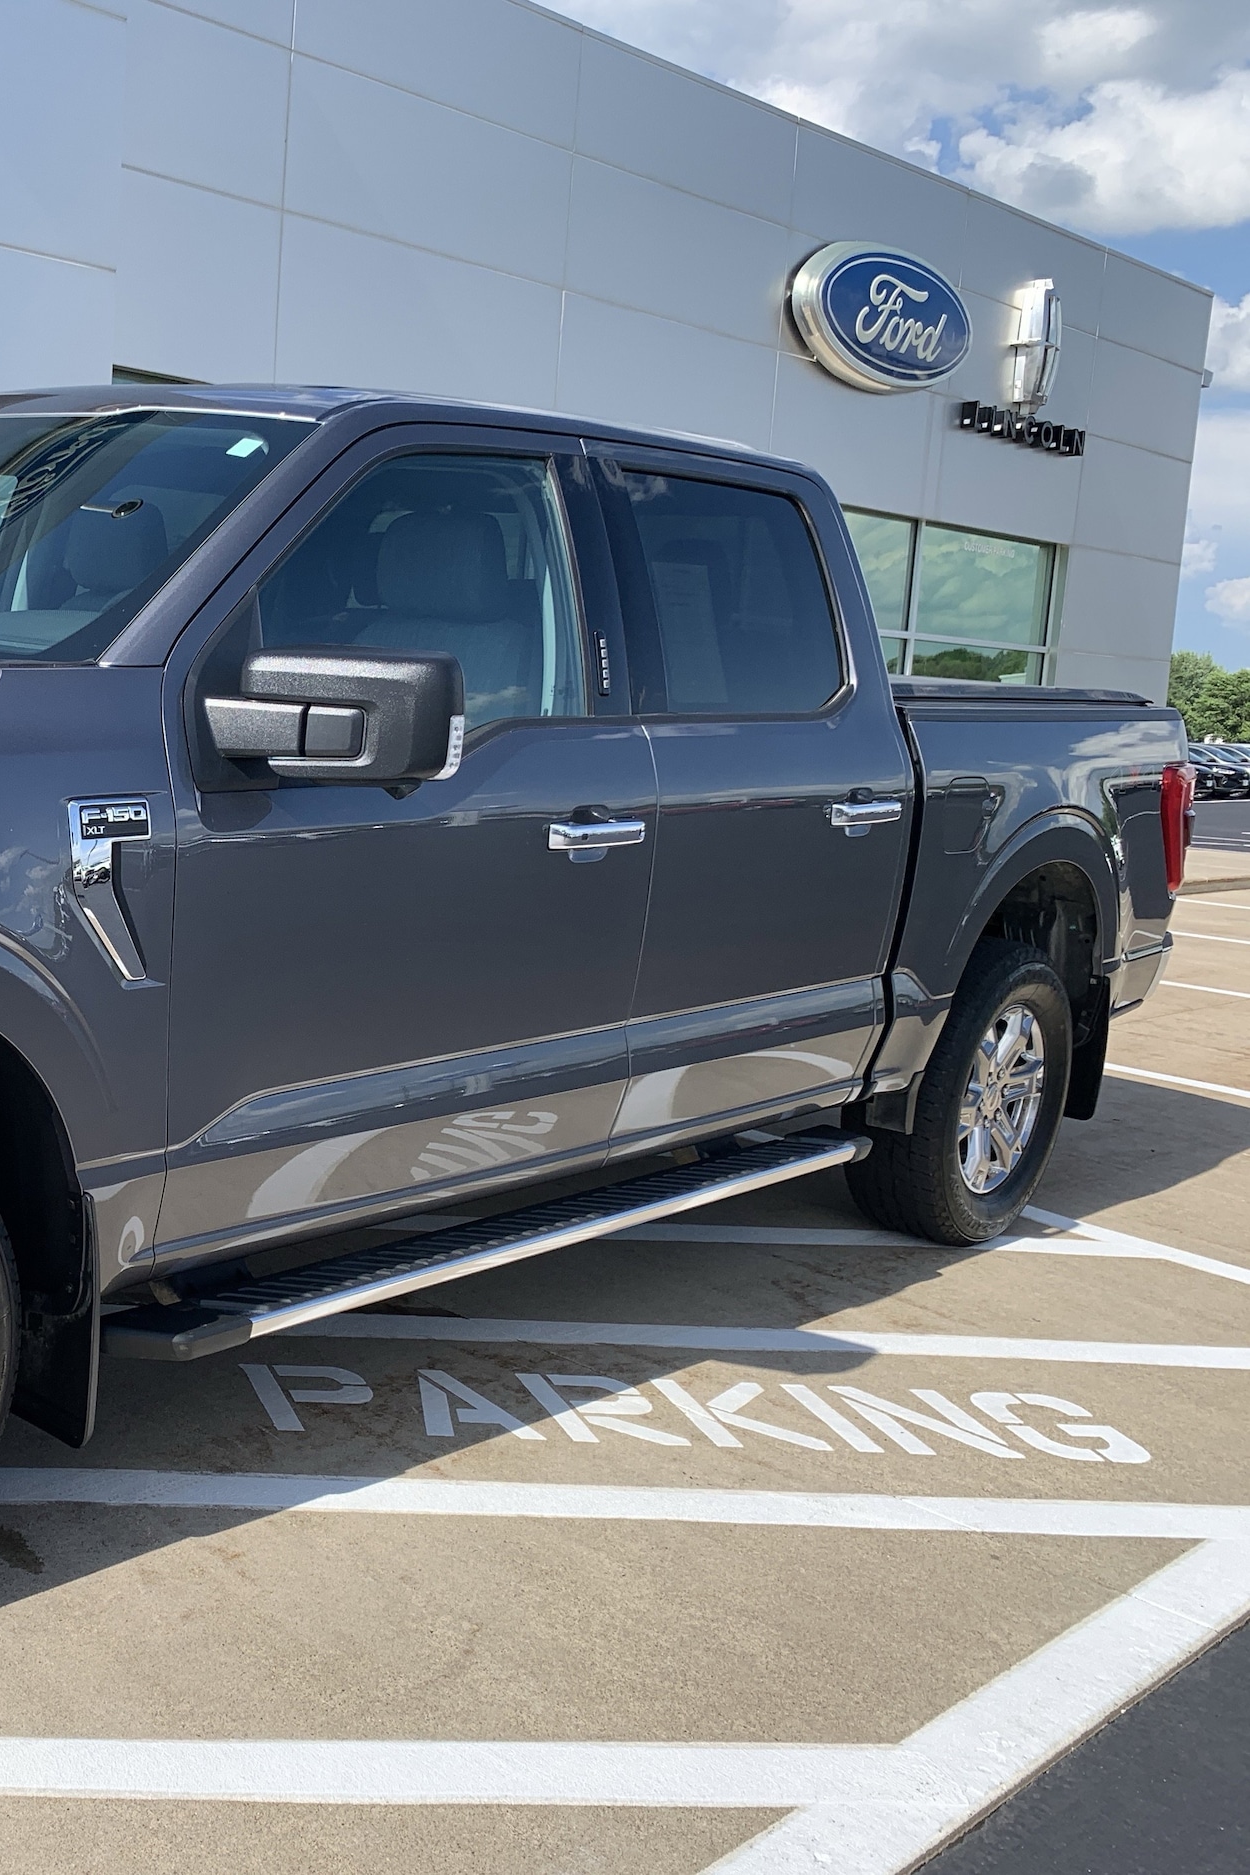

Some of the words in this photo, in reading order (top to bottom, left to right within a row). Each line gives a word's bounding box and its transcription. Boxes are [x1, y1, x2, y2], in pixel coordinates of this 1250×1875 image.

[855, 273, 948, 363] Ford
[961, 400, 1086, 456] LINCOLN
[81, 806, 147, 824] F-150
[86, 825, 106, 836] XLT
[238, 1363, 1152, 1464] PARKING
